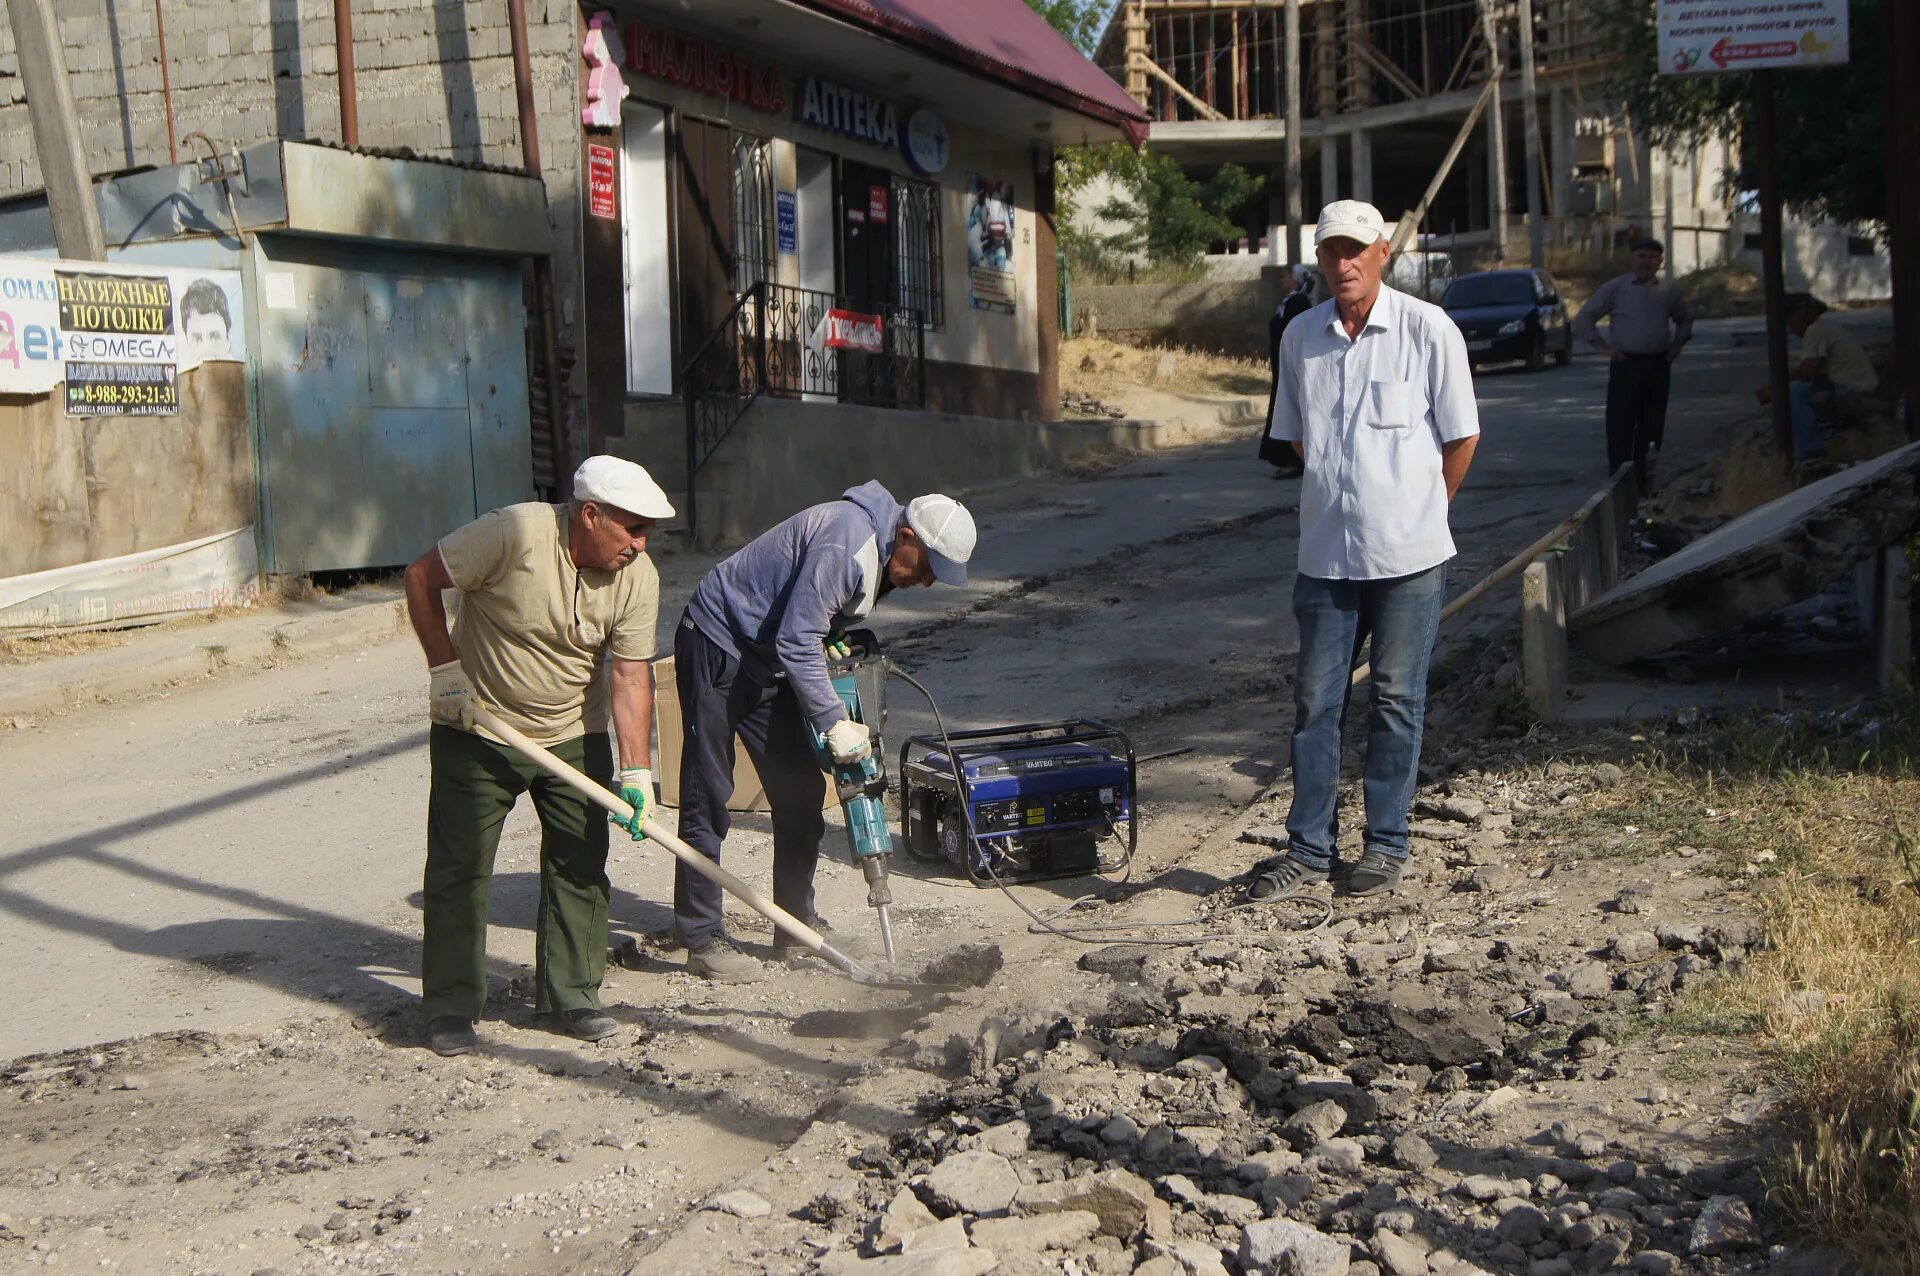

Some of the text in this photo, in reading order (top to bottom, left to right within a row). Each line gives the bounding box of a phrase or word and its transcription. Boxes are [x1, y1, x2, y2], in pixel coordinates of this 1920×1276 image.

[1679, 7, 1728, 21] ДЕТСКАЯ
[1729, 4, 1783, 17] БЫТОВАЯ
[1669, 24, 1732, 37] КОСМЕТИКА
[1736, 23, 1744, 32] И
[1745, 21, 1790, 32] МНОГОЕ
[632, 23, 789, 112] МАЛЮТКА
[803, 77, 899, 146] АПТЕКА
[58, 278, 170, 306] НАТЯЖНЫЕ
[72, 304, 164, 331] ПОТОЛКИ
[92, 339, 175, 358] OMEGA
[116, 363, 163, 383] ПОДАРОК
[85, 385, 176, 404] 8-988-293-21-31
[1026, 760, 1053, 768] VARTEG
[1003, 812, 1022, 821] VARTEG
